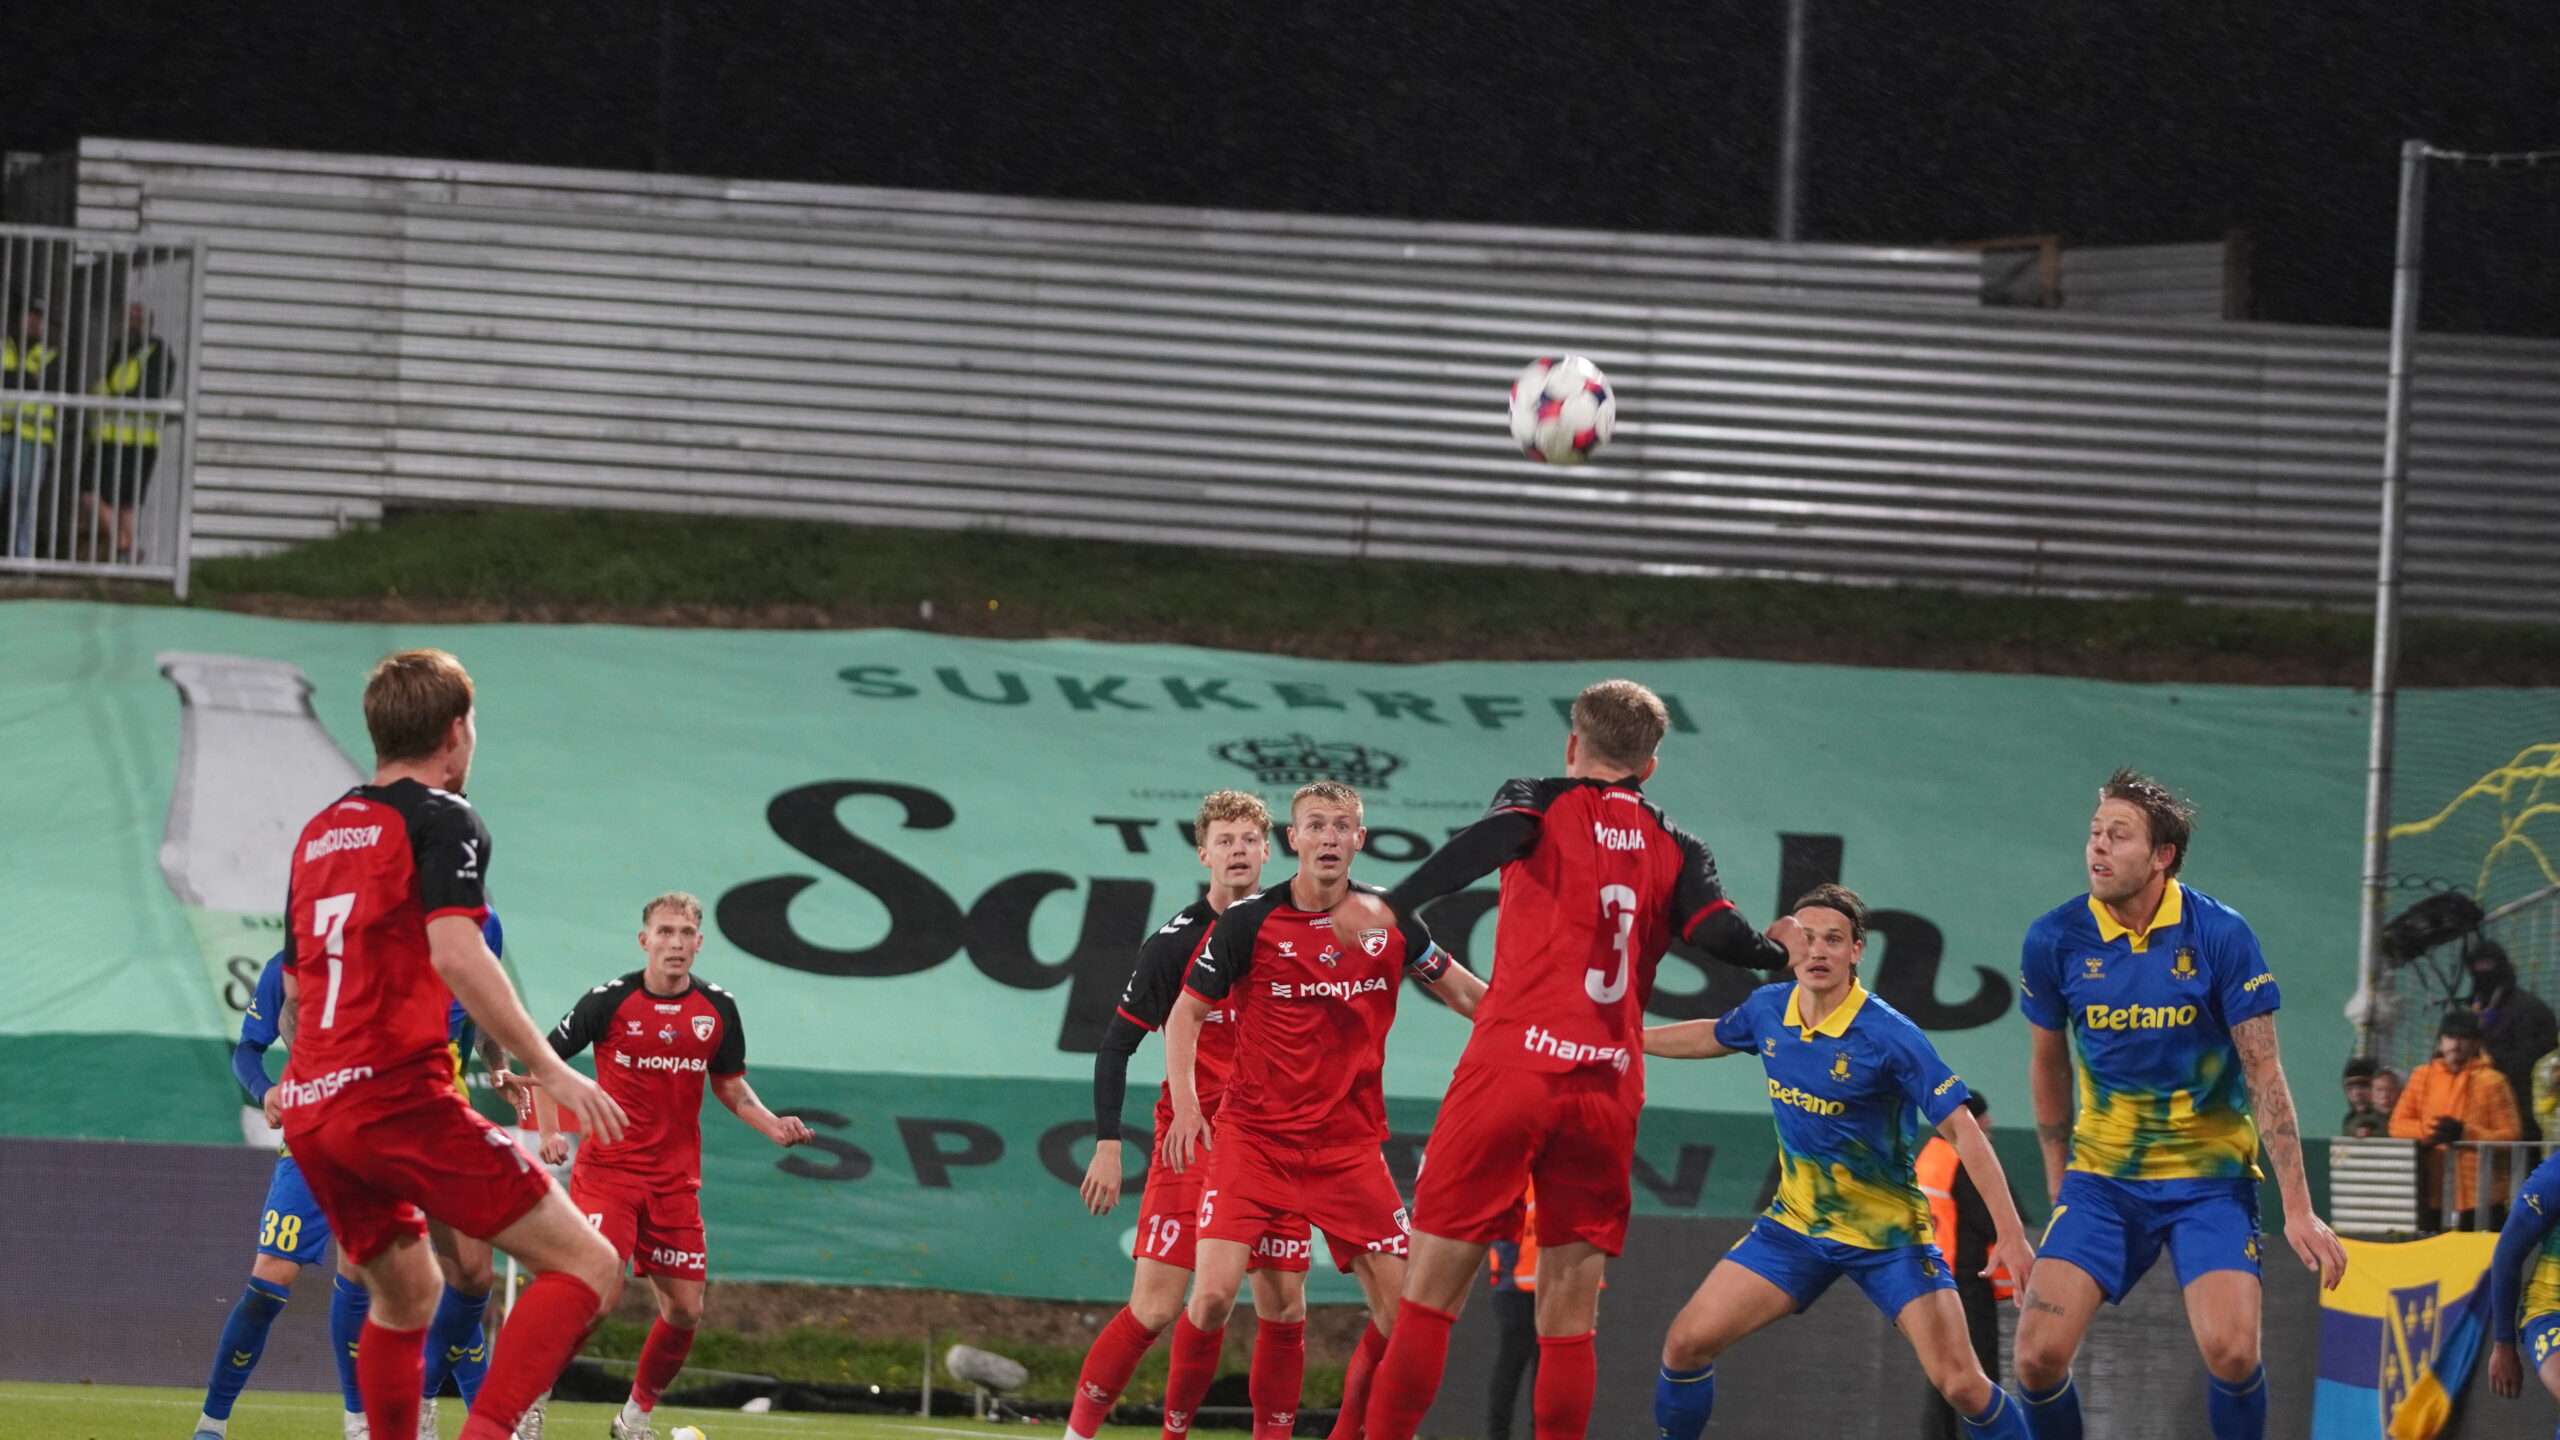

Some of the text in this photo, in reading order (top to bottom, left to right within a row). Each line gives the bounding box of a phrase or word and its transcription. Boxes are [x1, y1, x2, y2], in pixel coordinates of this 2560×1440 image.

[313, 892, 356, 1029] 7
[1584, 884, 1637, 1004] 3
[1300, 977, 1388, 1001] MONJASA
[2086, 1003, 2198, 1031] Betano
[637, 1056, 708, 1074] MONJASA
[1768, 1077, 1845, 1116] Betano
[1197, 1190, 1218, 1228] 5
[260, 1209, 302, 1252] 38
[1148, 1214, 1182, 1257] 19
